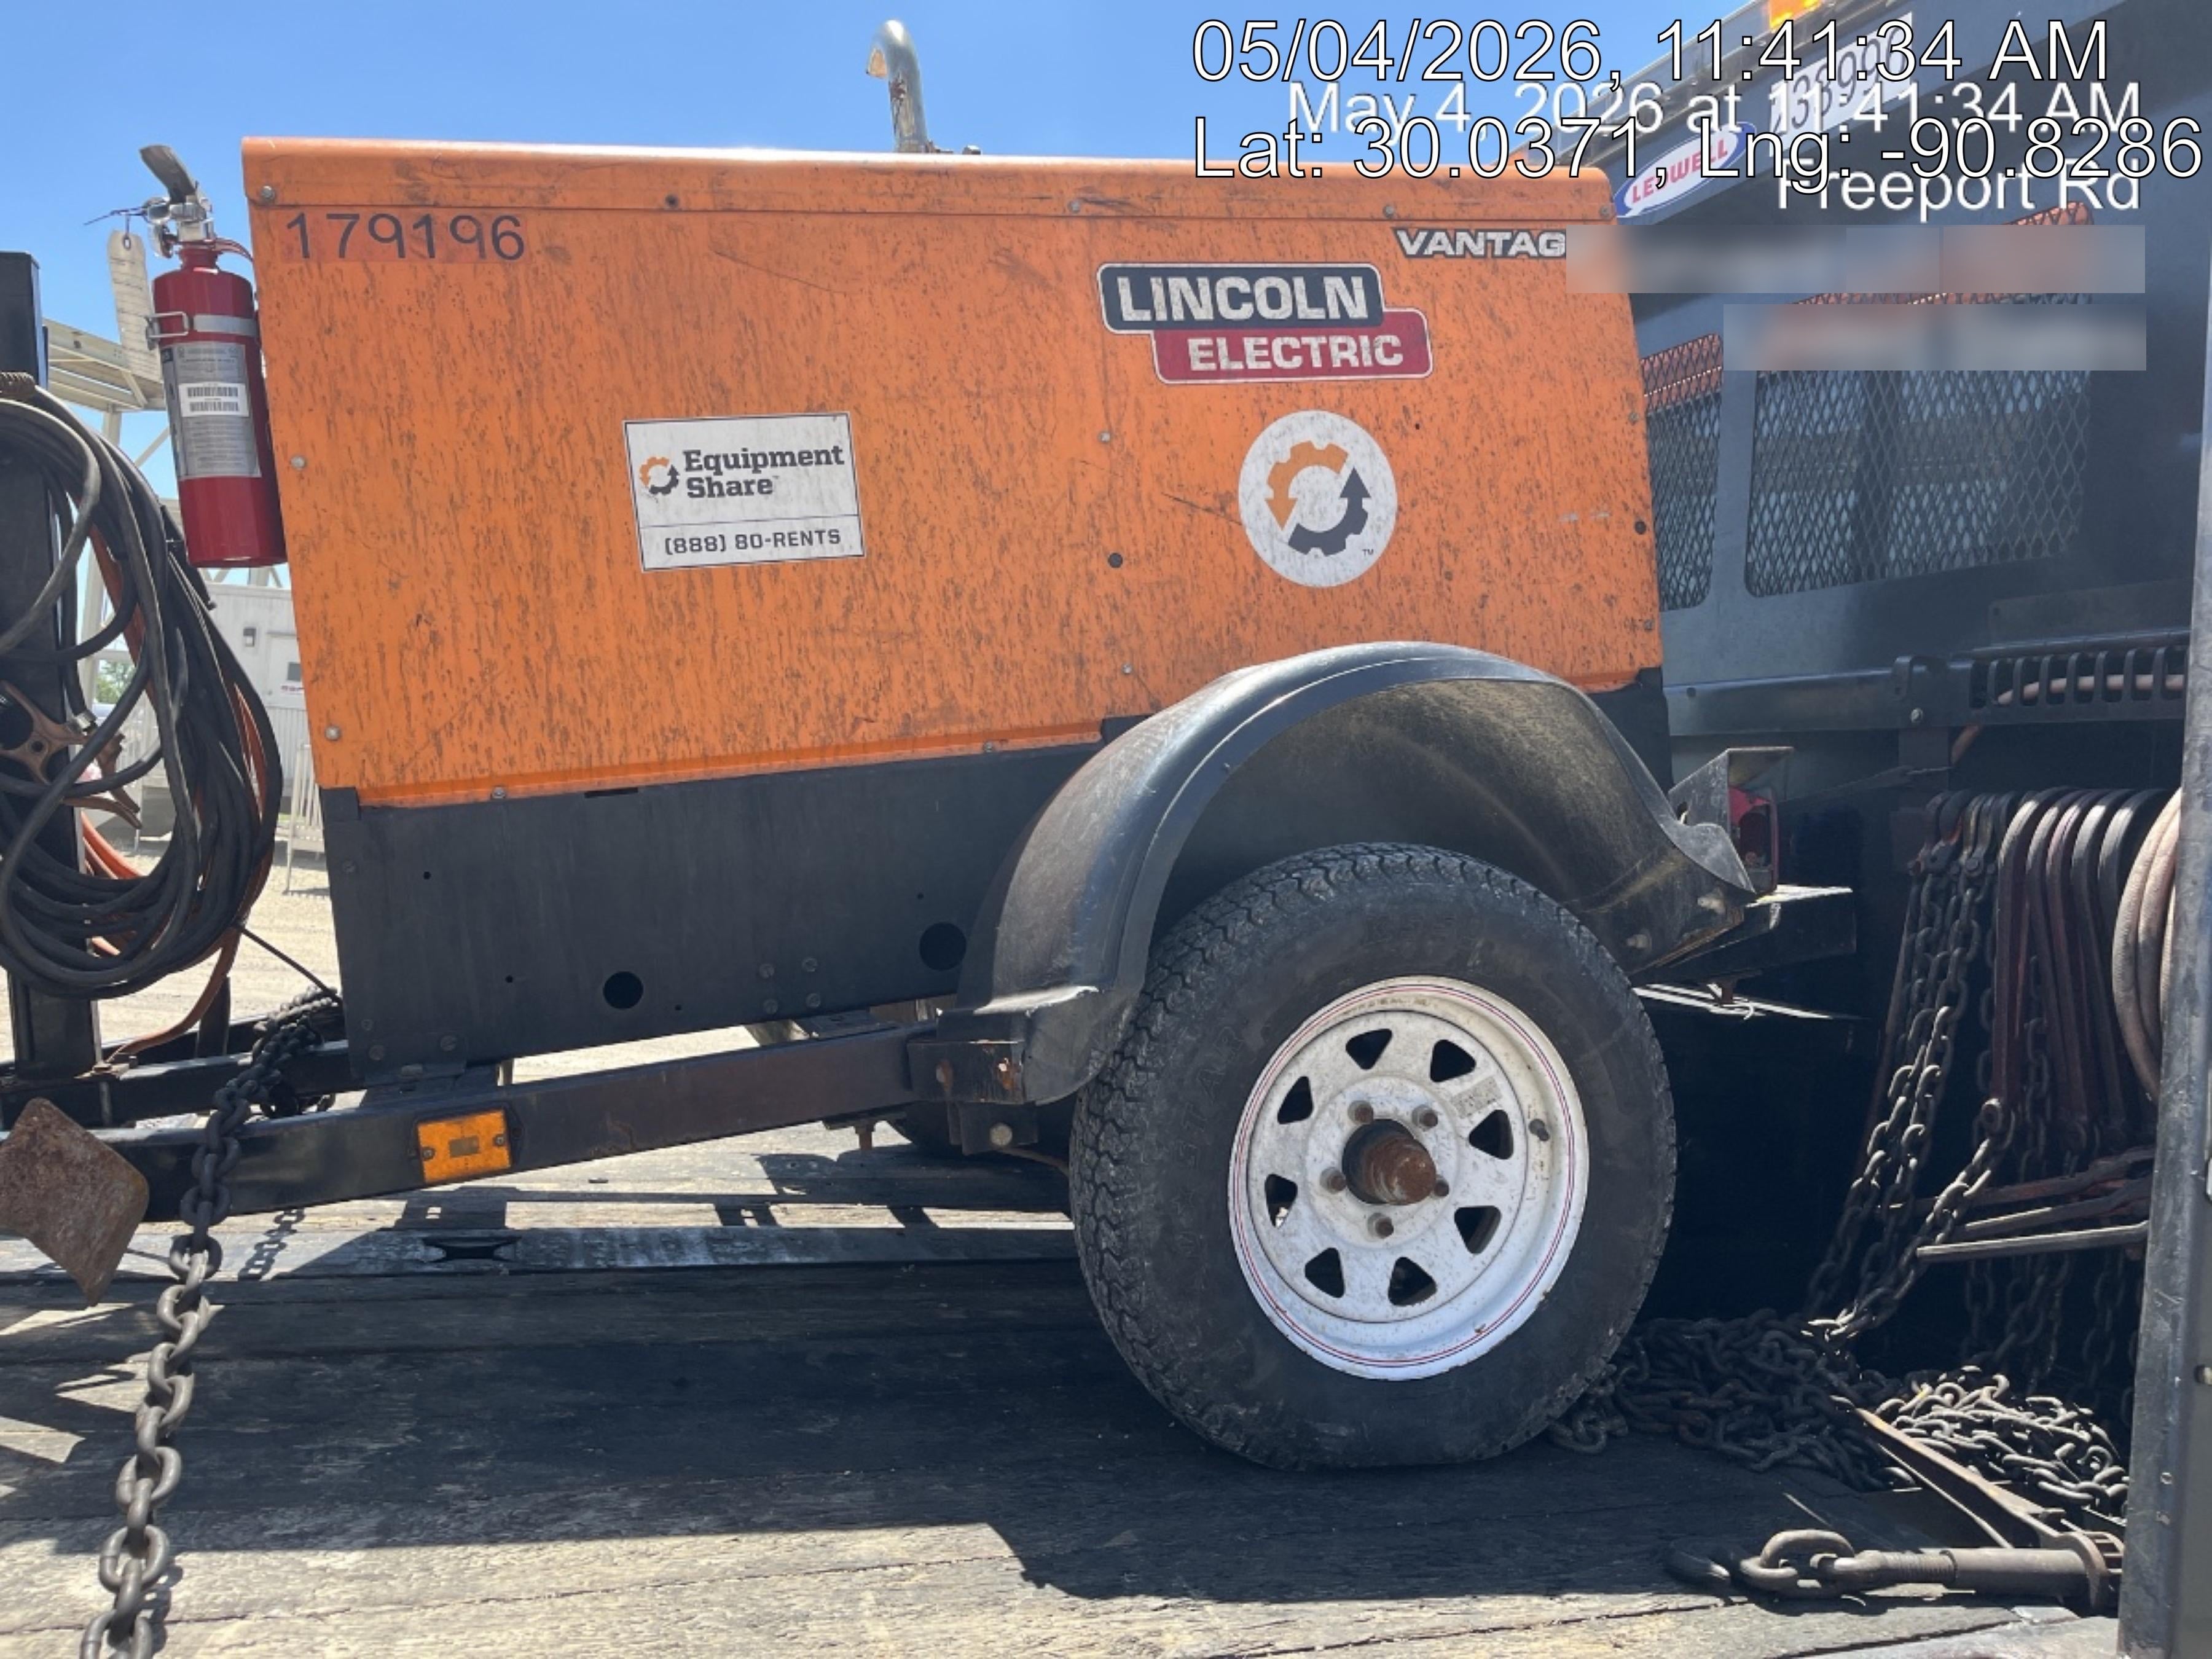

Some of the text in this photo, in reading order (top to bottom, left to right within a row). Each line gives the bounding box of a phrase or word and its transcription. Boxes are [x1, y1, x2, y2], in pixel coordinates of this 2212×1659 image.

[287, 213, 525, 261] 179196
[1397, 230, 1566, 257] VANTAG
[1116, 276, 1368, 322] LINCOLN
[1188, 335, 1404, 372] ELECTRIC
[683, 445, 845, 476] Equipment
[686, 476, 774, 499] Share
[735, 528, 841, 551] 80-RENTS
